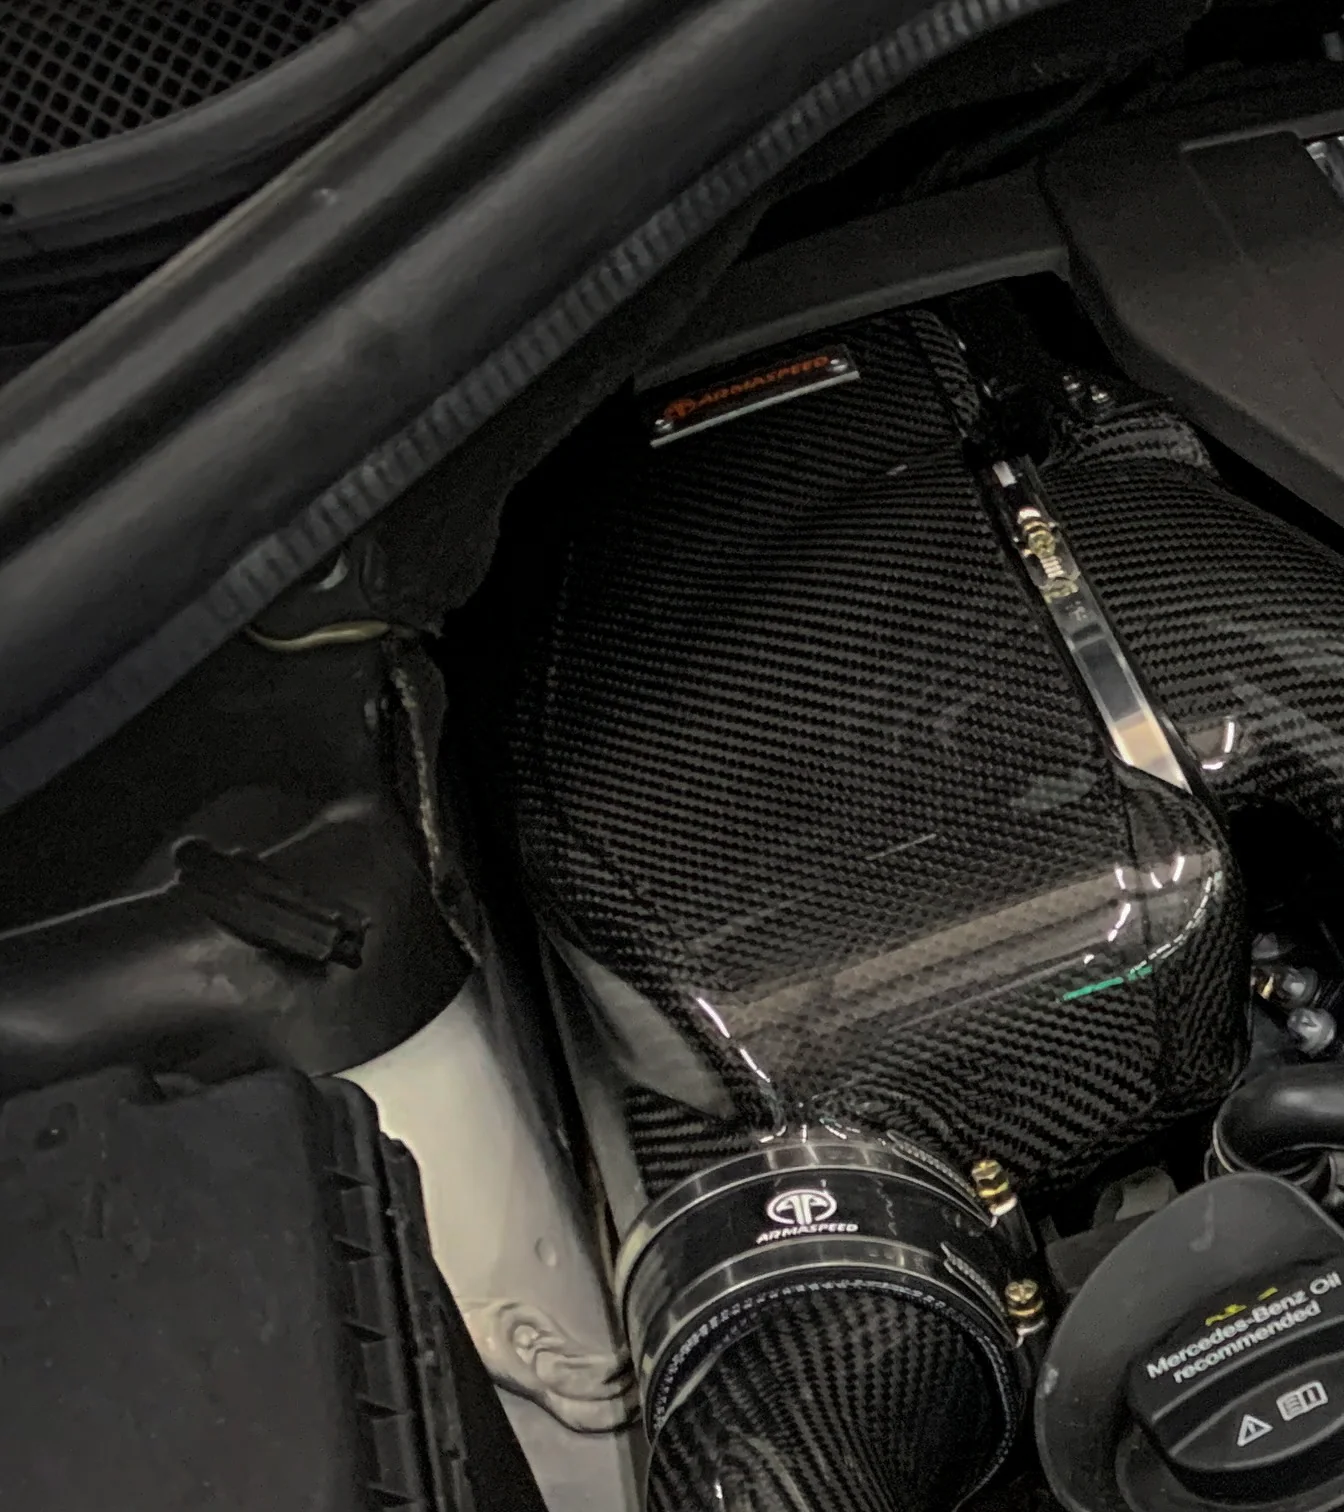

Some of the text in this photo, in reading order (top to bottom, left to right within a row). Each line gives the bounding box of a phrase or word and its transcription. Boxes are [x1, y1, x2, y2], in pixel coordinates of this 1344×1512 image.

[756, 1223, 859, 1245] ARMASPEED
[1146, 1271, 1343, 1379] Mercedes-Benz Oil
[1173, 1299, 1322, 1383] recommended
